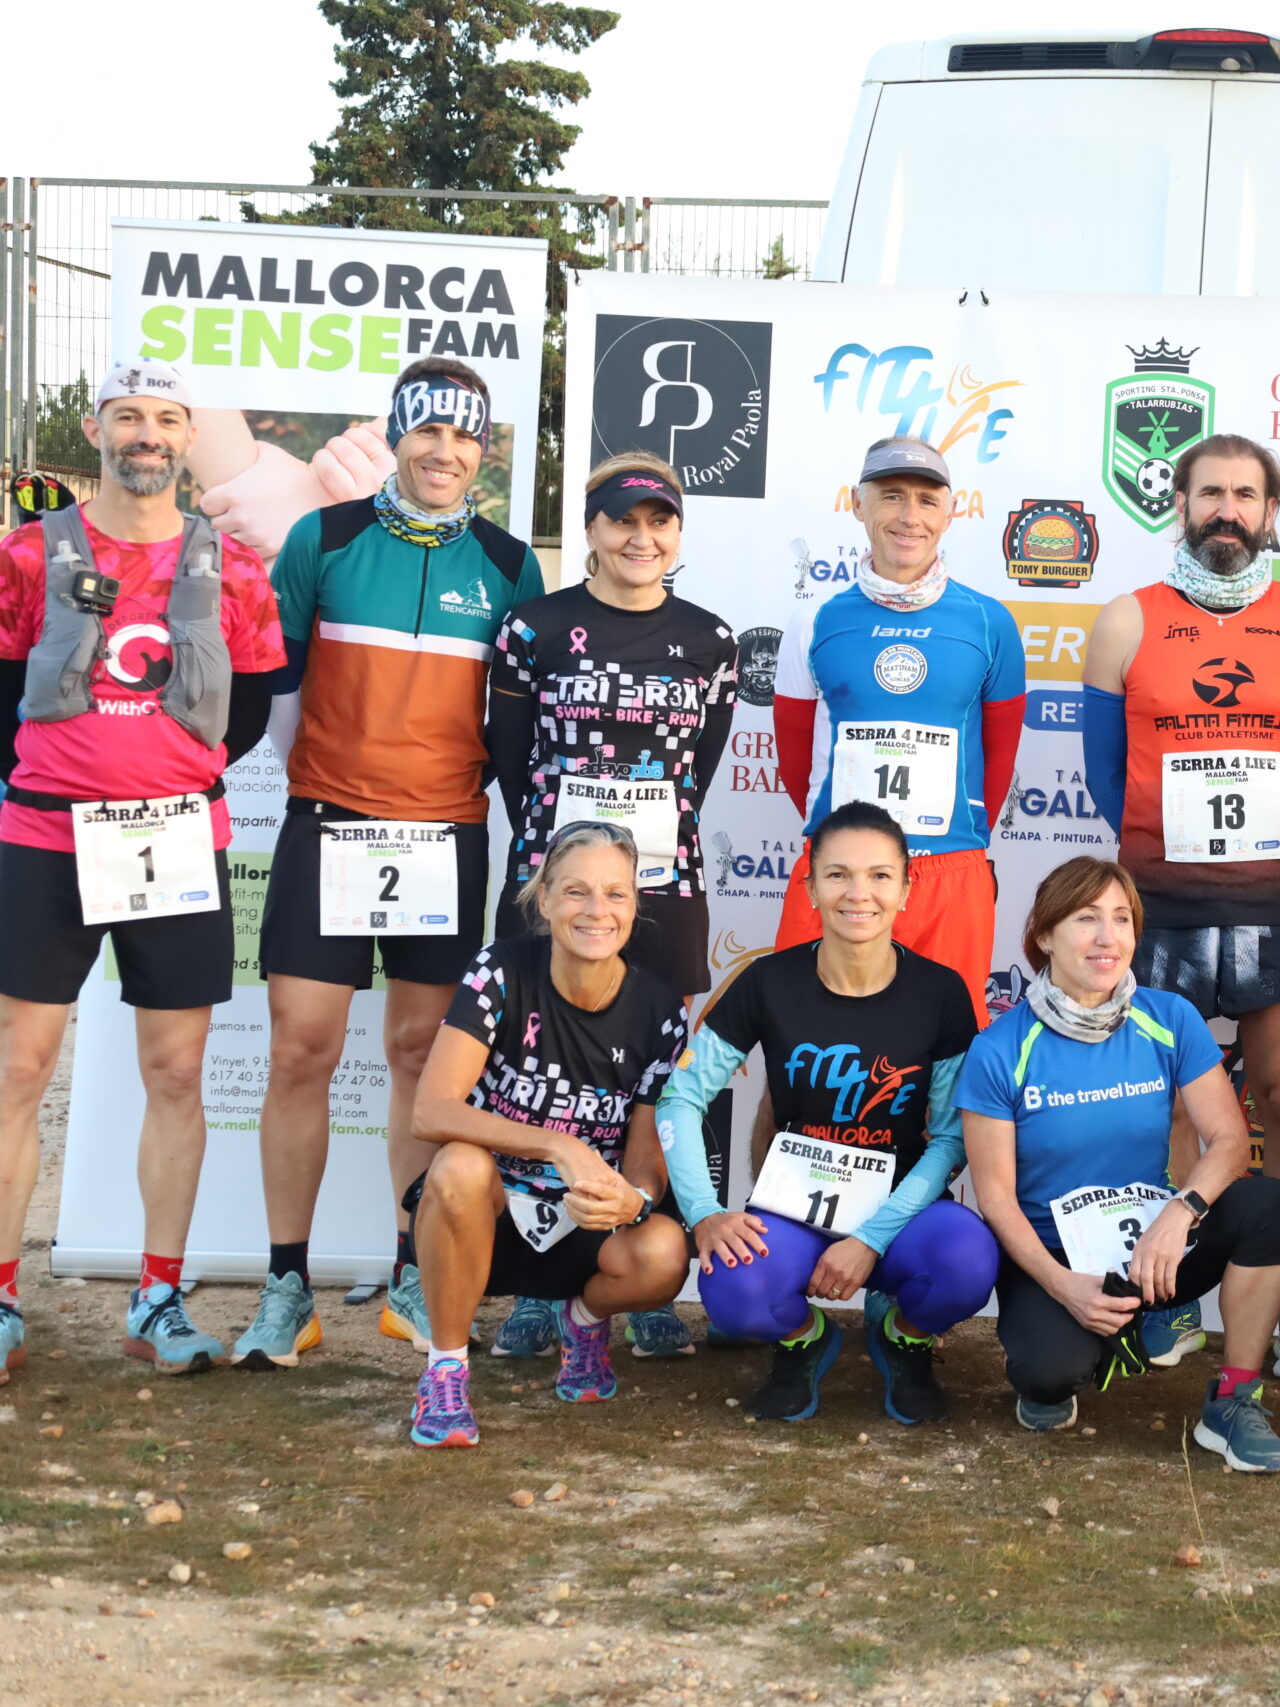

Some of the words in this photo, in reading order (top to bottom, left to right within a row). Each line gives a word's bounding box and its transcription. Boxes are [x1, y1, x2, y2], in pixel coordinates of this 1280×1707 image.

[141, 251, 515, 315] MALLORCA
[139, 305, 401, 374] SENSE
[407, 318, 520, 360] FAM
[146, 378, 177, 389] BOC
[1115, 386, 1156, 399] SPORTING
[402, 381, 480, 433] Buff
[1130, 399, 1194, 413] TALARRUBIAS
[682, 446, 741, 488] Royal
[732, 389, 762, 450] Paola
[1012, 564, 1041, 576] TOMY
[1042, 565, 1089, 577] BURGUER
[440, 603, 491, 619] TRENCAFITES
[871, 625, 932, 638] land
[555, 705, 600, 720] SWIM
[616, 710, 653, 724] BIKE
[669, 713, 699, 727] RUN
[1154, 713, 1220, 731] PALMA
[846, 728, 896, 740] SERRA
[901, 729, 911, 740] 4
[915, 730, 950, 746] LIFE
[1174, 732, 1203, 740] CLUB
[874, 747, 903, 756] SENSE
[875, 741, 916, 749] MALLORCA
[1171, 757, 1227, 772] SERRA
[1231, 757, 1241, 769] 4
[1245, 756, 1277, 770] LIFE
[1205, 770, 1248, 778] MALLORCA
[874, 764, 911, 801] 14
[1205, 778, 1235, 786] SENSE
[566, 783, 618, 800] SERRA
[623, 789, 632, 801] 4
[635, 787, 668, 801] LIFE
[595, 802, 636, 810] MALLORCA
[595, 808, 625, 817] SENSE
[1207, 794, 1246, 830] 13
[83, 808, 144, 823] SERRA
[150, 806, 160, 818] 4
[121, 820, 165, 829] MALLORCA
[230, 816, 281, 829] mpartir,
[331, 828, 389, 841] SERRA
[395, 829, 404, 840] 4
[410, 829, 446, 842] LIFE
[1001, 829, 1042, 842] CHAPA
[1053, 833, 1103, 845] PINTURA
[367, 849, 398, 857] SENSE
[138, 846, 155, 882] 1
[379, 866, 400, 902] 2
[717, 888, 750, 897] CHAPA
[208, 1023, 246, 1033] guenos
[250, 1024, 263, 1032] en
[355, 1028, 367, 1036] us
[211, 1056, 248, 1068] Vinyet,
[253, 1057, 260, 1067] 9
[354, 1060, 388, 1072] Palma
[209, 1071, 233, 1081] 617
[237, 1072, 253, 1082] 40
[350, 1075, 366, 1086] 47
[369, 1076, 386, 1087] 06
[210, 1086, 266, 1098] info@mall
[1024, 1085, 1043, 1109] B
[1047, 1091, 1075, 1106] the
[1077, 1082, 1123, 1103] travel
[1125, 1076, 1166, 1097] brand
[489, 1092, 529, 1125] SWIM
[543, 1118, 580, 1137] BIKE
[592, 1127, 623, 1139] RUN
[802, 1124, 892, 1145] MALLORCA
[780, 1139, 833, 1164] SERRA
[838, 1153, 849, 1166] 4
[853, 1156, 888, 1173] LIFE
[808, 1170, 837, 1183] SENSE
[810, 1162, 852, 1177] MALLORCA
[1061, 1188, 1120, 1215] SERRA
[1123, 1186, 1134, 1195] 4
[804, 1190, 840, 1229] 11
[1102, 1202, 1134, 1216] SENSE
[535, 1202, 559, 1235] 9
[1118, 1218, 1143, 1251] 3
